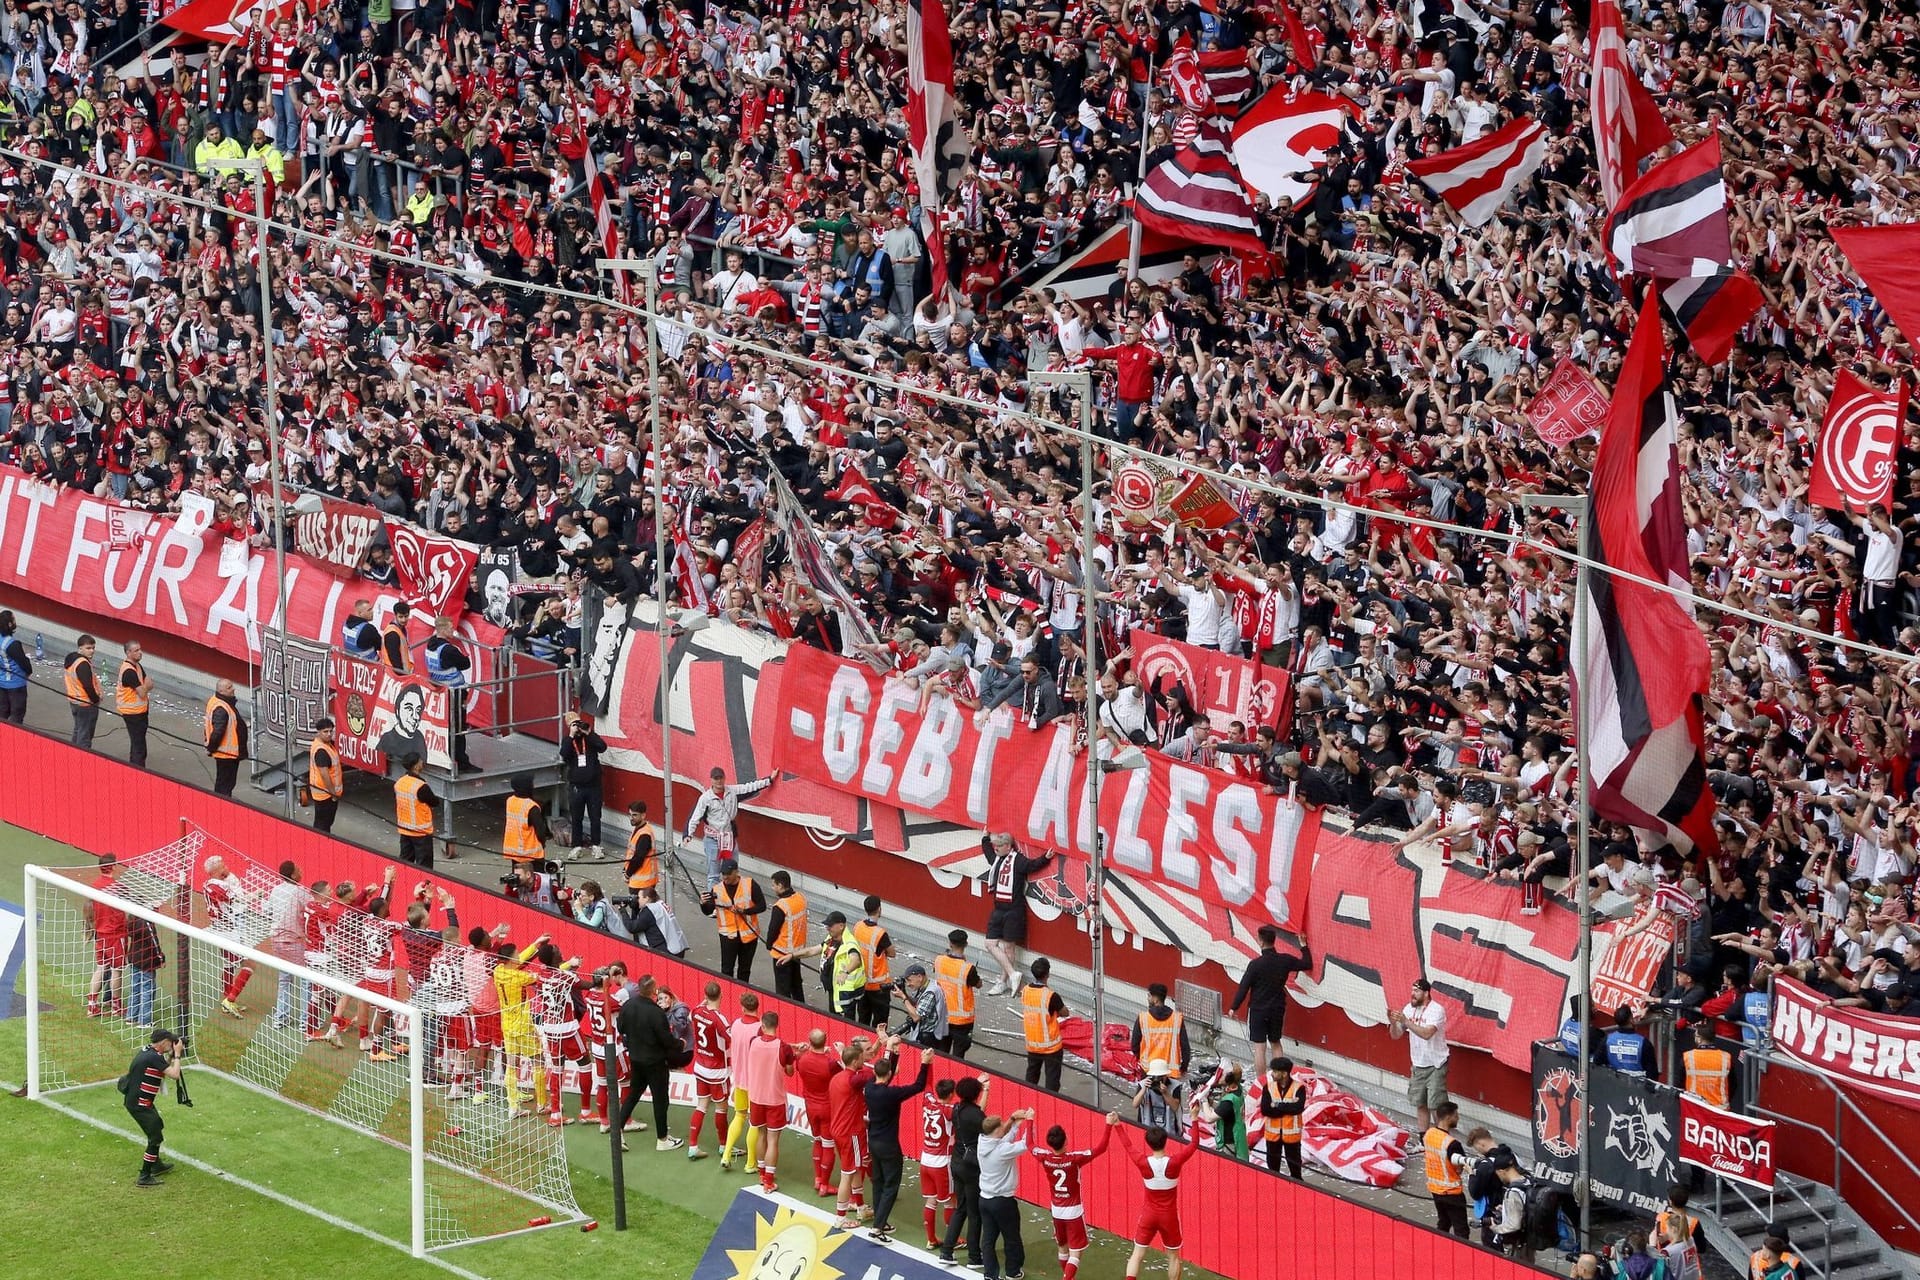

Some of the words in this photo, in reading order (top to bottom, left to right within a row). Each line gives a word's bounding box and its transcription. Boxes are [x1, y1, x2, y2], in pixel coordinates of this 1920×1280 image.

[61, 498, 204, 626] FÜR
[497, 552, 510, 566] 85
[265, 646, 324, 695] VECHIO
[336, 656, 378, 696] ULTRAS
[379, 672, 447, 721] UNTED
[369, 712, 387, 742] WE
[1027, 722, 1305, 926] ALLES!
[697, 1022, 708, 1049] 3
[1684, 1117, 1771, 1169] BANDA
[1053, 1169, 1068, 1193] 2
